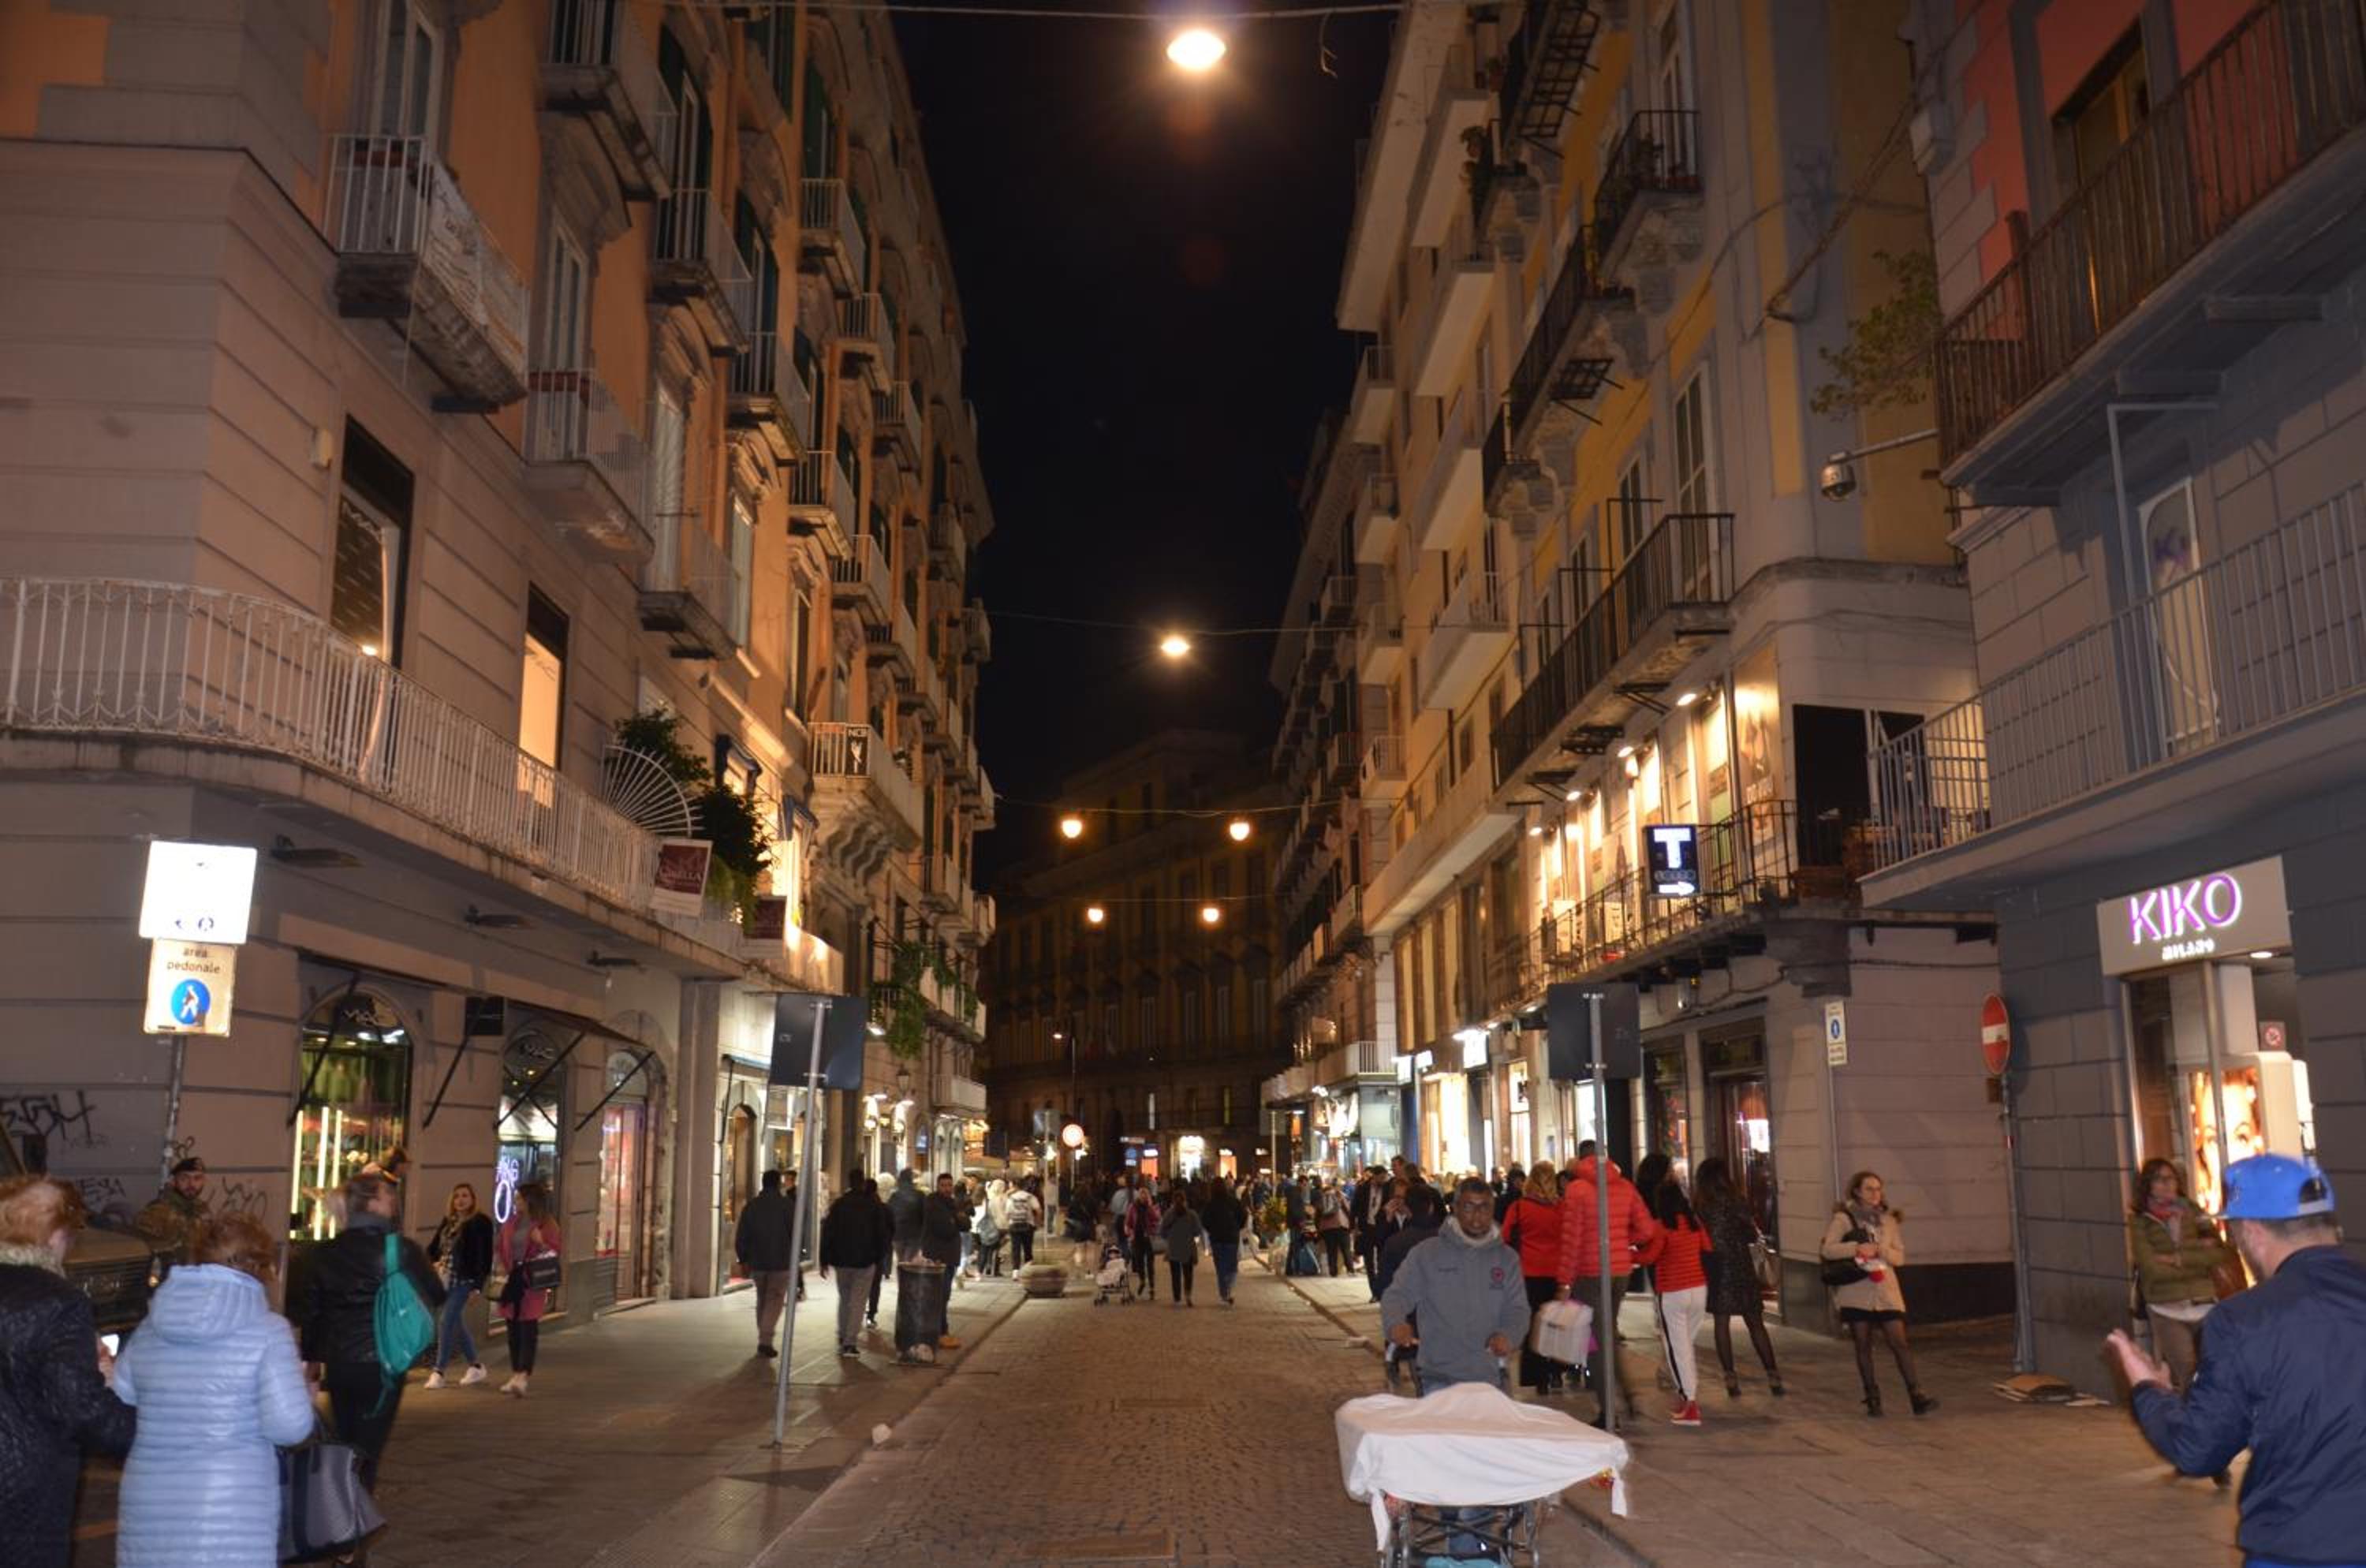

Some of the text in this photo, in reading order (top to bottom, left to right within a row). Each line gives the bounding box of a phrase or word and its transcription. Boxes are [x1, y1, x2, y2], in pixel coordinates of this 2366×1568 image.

[1654, 827, 1692, 868] T
[2129, 873, 2242, 944] KIKO
[183, 947, 207, 958] area
[166, 961, 221, 974] pedonale
